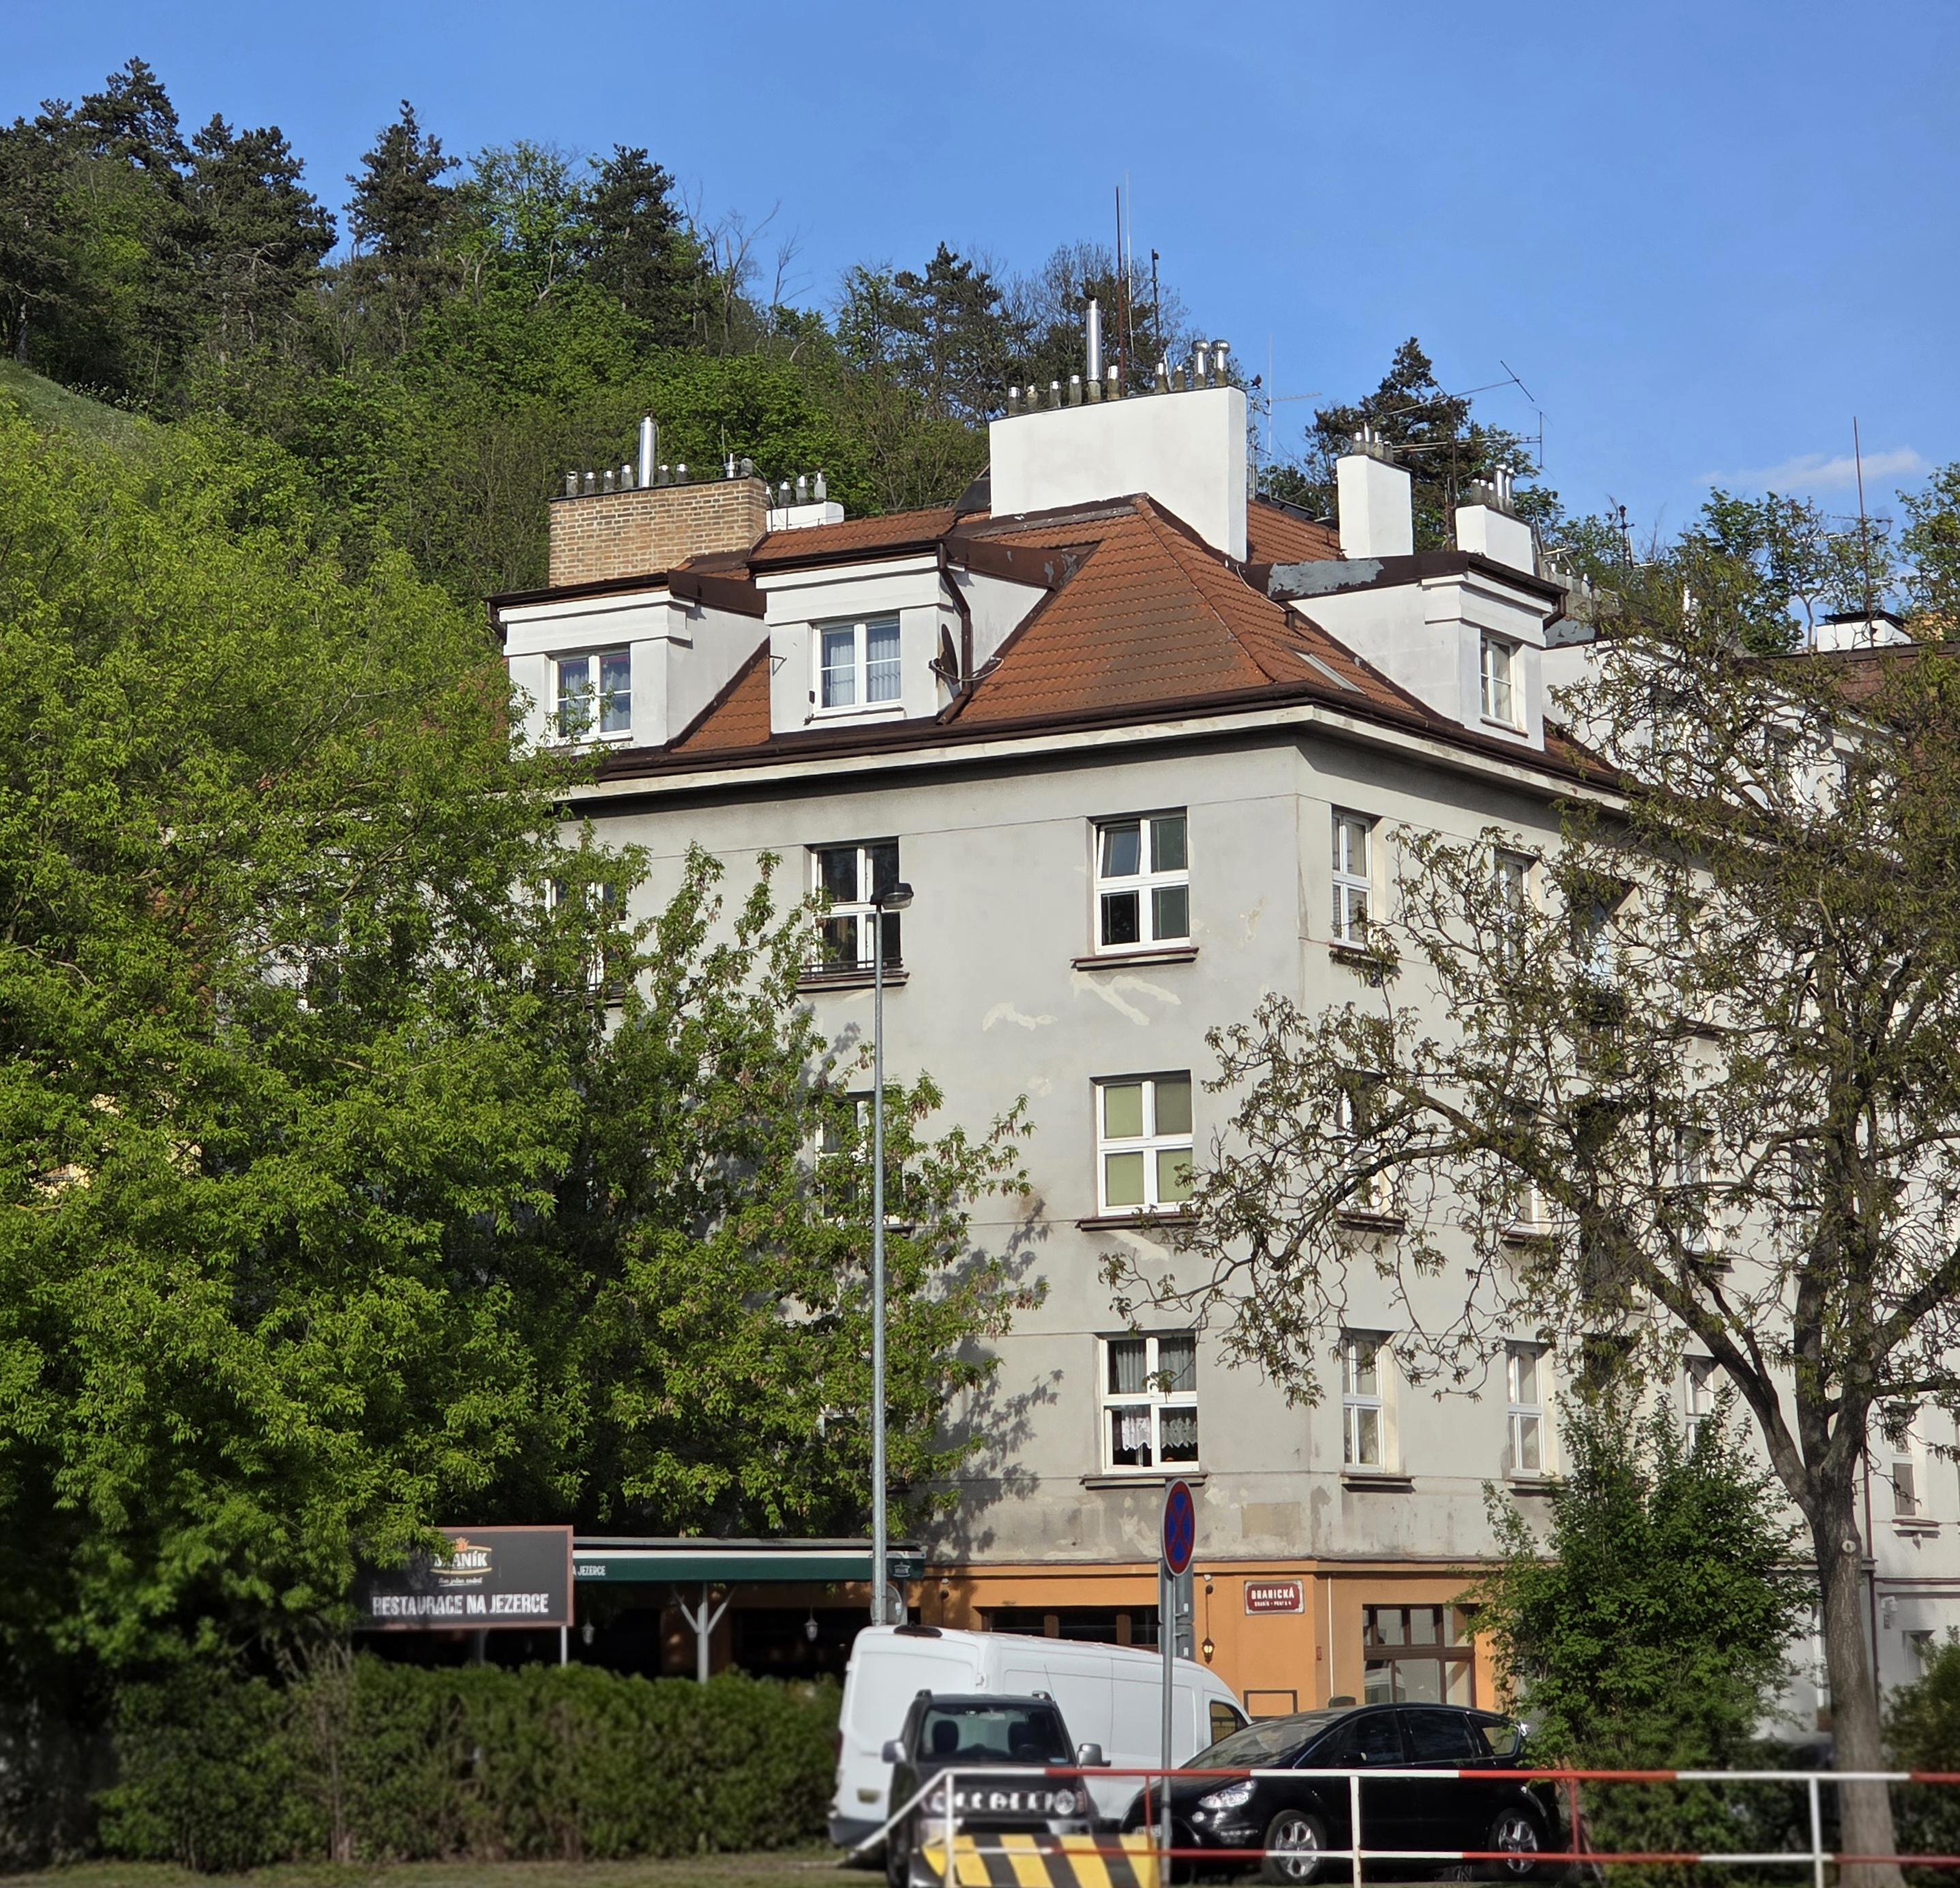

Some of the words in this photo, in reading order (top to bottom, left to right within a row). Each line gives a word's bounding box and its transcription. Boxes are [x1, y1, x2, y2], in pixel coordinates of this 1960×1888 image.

[434, 1550, 488, 1567] BANÍK
[578, 1565, 606, 1576] JEZERCE
[1251, 1587, 1294, 1599] BRANICKÁ
[372, 1595, 463, 1616] RESTAURACE
[466, 1594, 486, 1614] NA
[489, 1593, 549, 1613] JEZERCE
